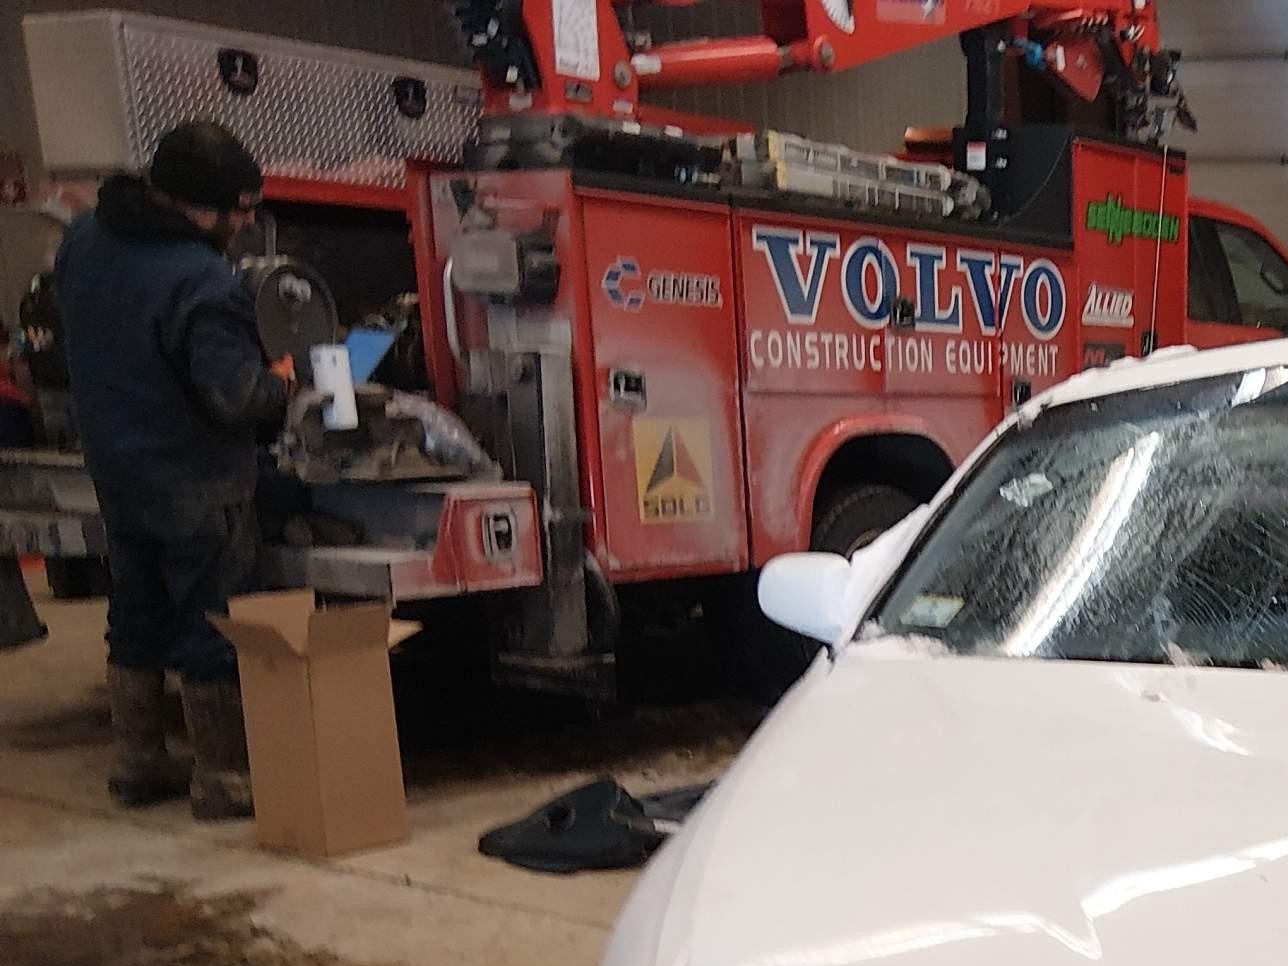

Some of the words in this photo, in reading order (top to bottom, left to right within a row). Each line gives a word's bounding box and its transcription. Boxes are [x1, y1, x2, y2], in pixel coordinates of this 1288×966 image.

[648, 270, 722, 307] GENESIS
[752, 224, 1066, 340] VOLVO
[1082, 283, 1134, 327] ALLIED
[750, 328, 933, 373] CONSTRUCTION
[945, 339, 1059, 377] EQUIPMENT
